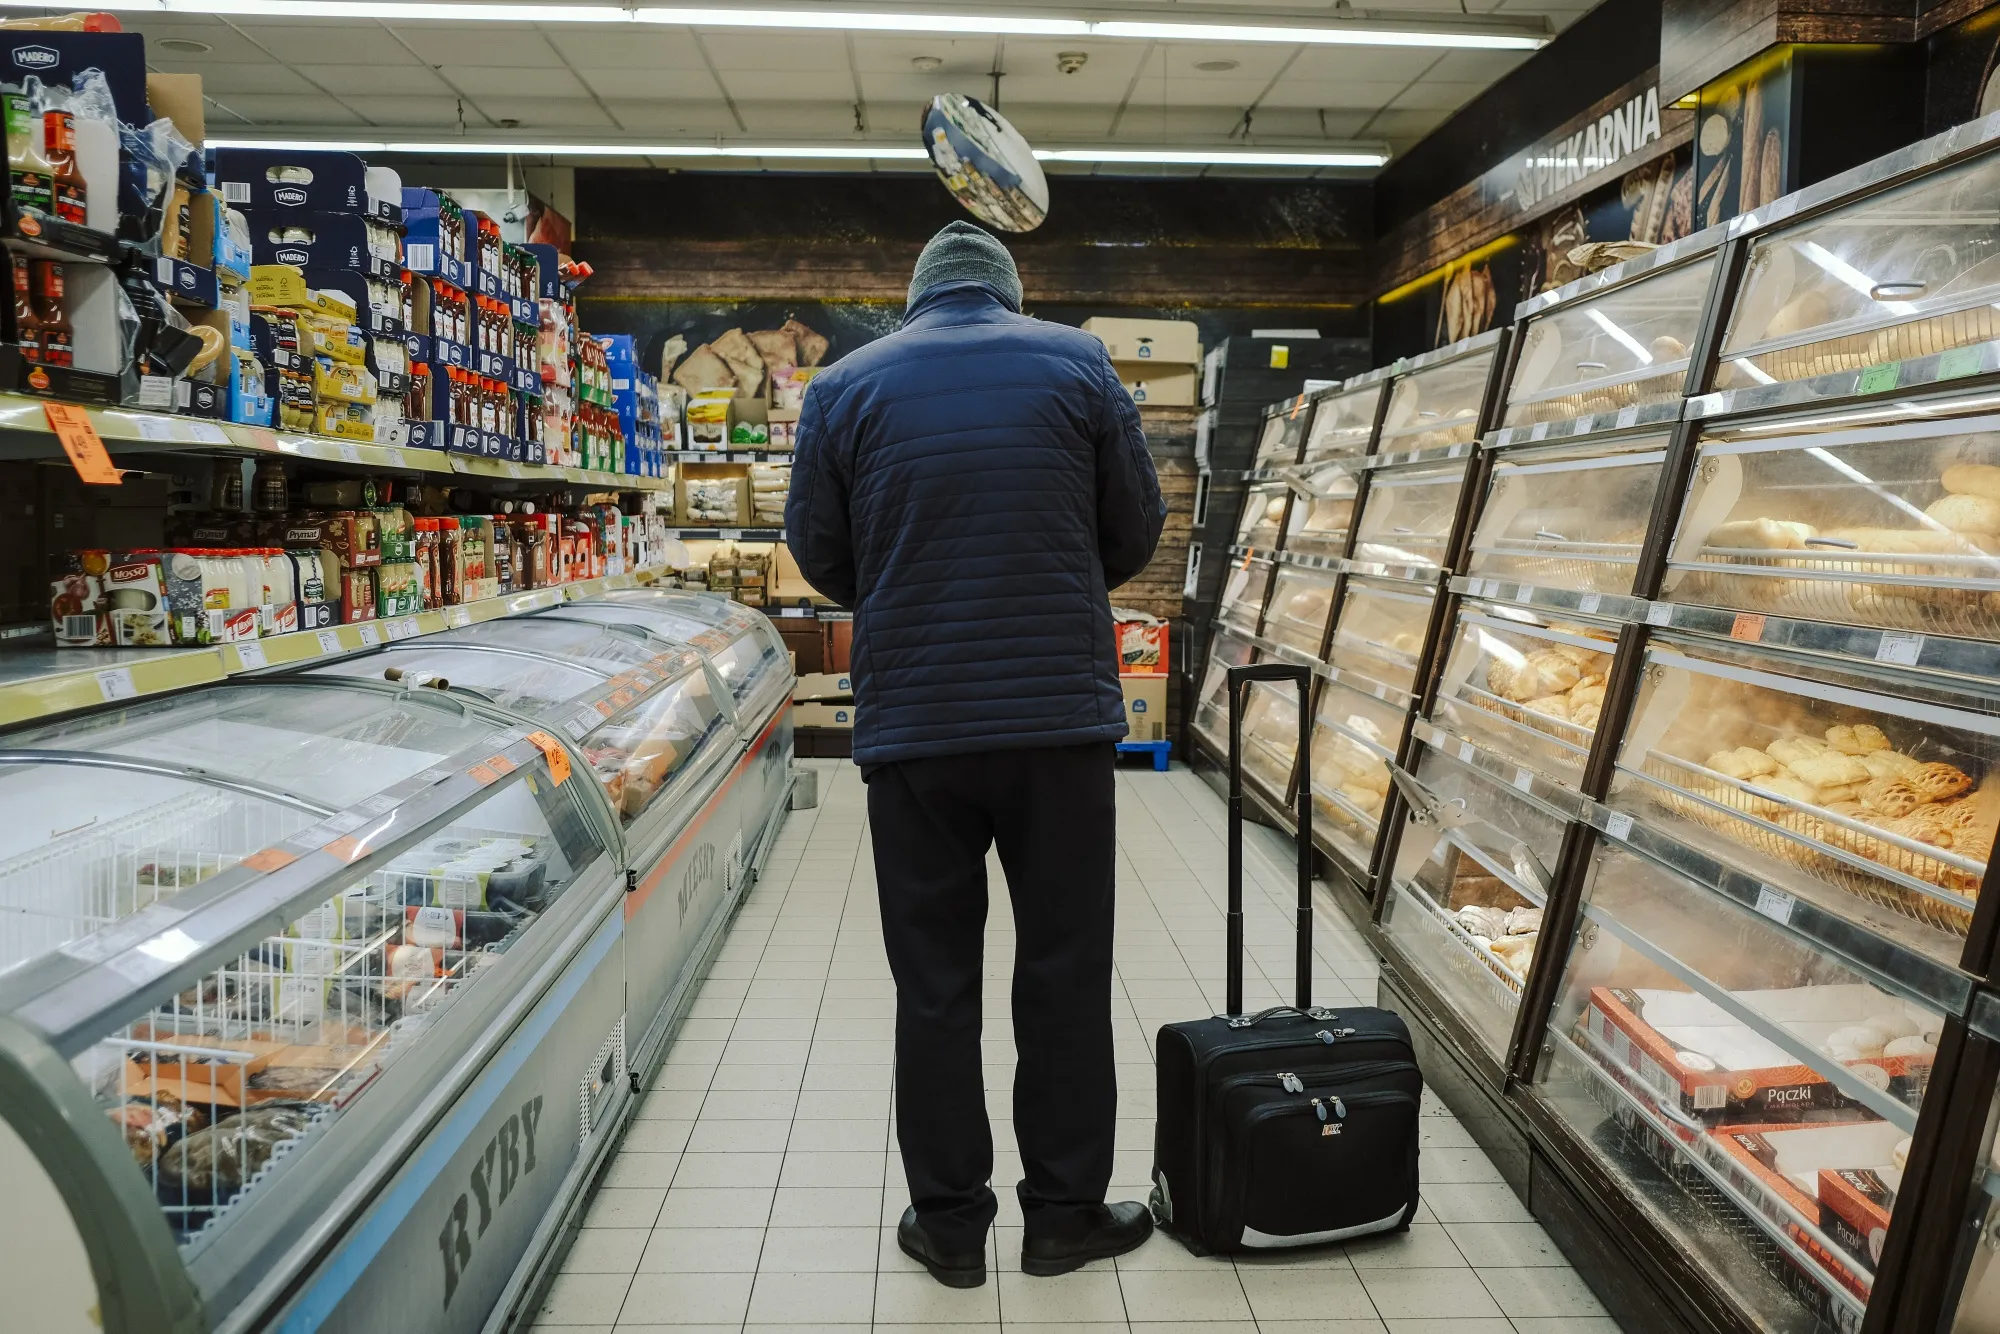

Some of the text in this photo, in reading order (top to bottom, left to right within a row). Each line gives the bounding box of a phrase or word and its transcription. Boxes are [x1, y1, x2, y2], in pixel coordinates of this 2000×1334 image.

[17, 48, 56, 64] MADERO
[1536, 86, 1662, 202] PIEKARNIA
[278, 190, 304, 202] MADERO
[280, 252, 306, 263] MADERO
[289, 530, 317, 540] Prymat
[677, 842, 716, 931] MIĘSNY
[1768, 1086, 1811, 1104] Pączki
[439, 1095, 543, 1313] RYBY
